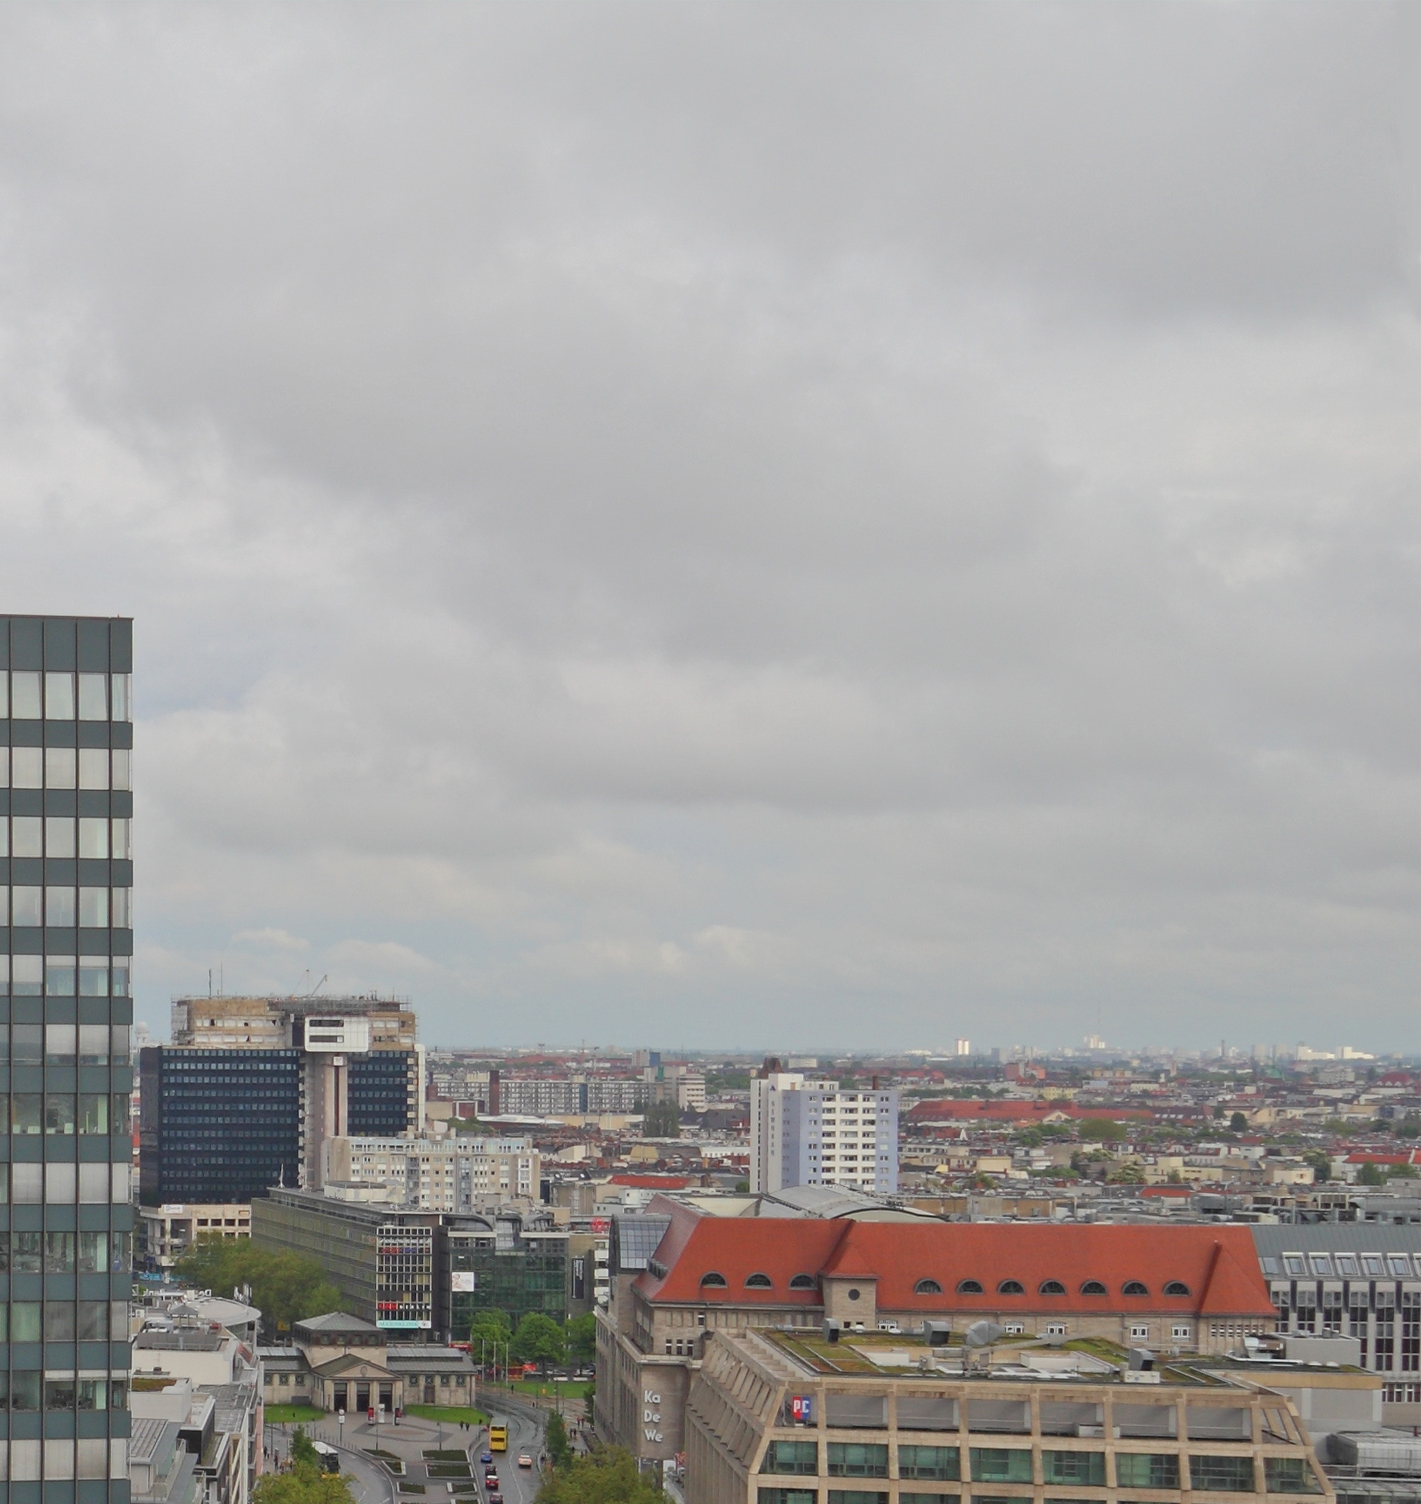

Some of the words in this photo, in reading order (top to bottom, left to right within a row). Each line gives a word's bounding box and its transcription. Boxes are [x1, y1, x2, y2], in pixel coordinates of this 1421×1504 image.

[644, 1389, 661, 1404] Ka
[644, 1409, 662, 1423] De
[644, 1429, 664, 1443] We
